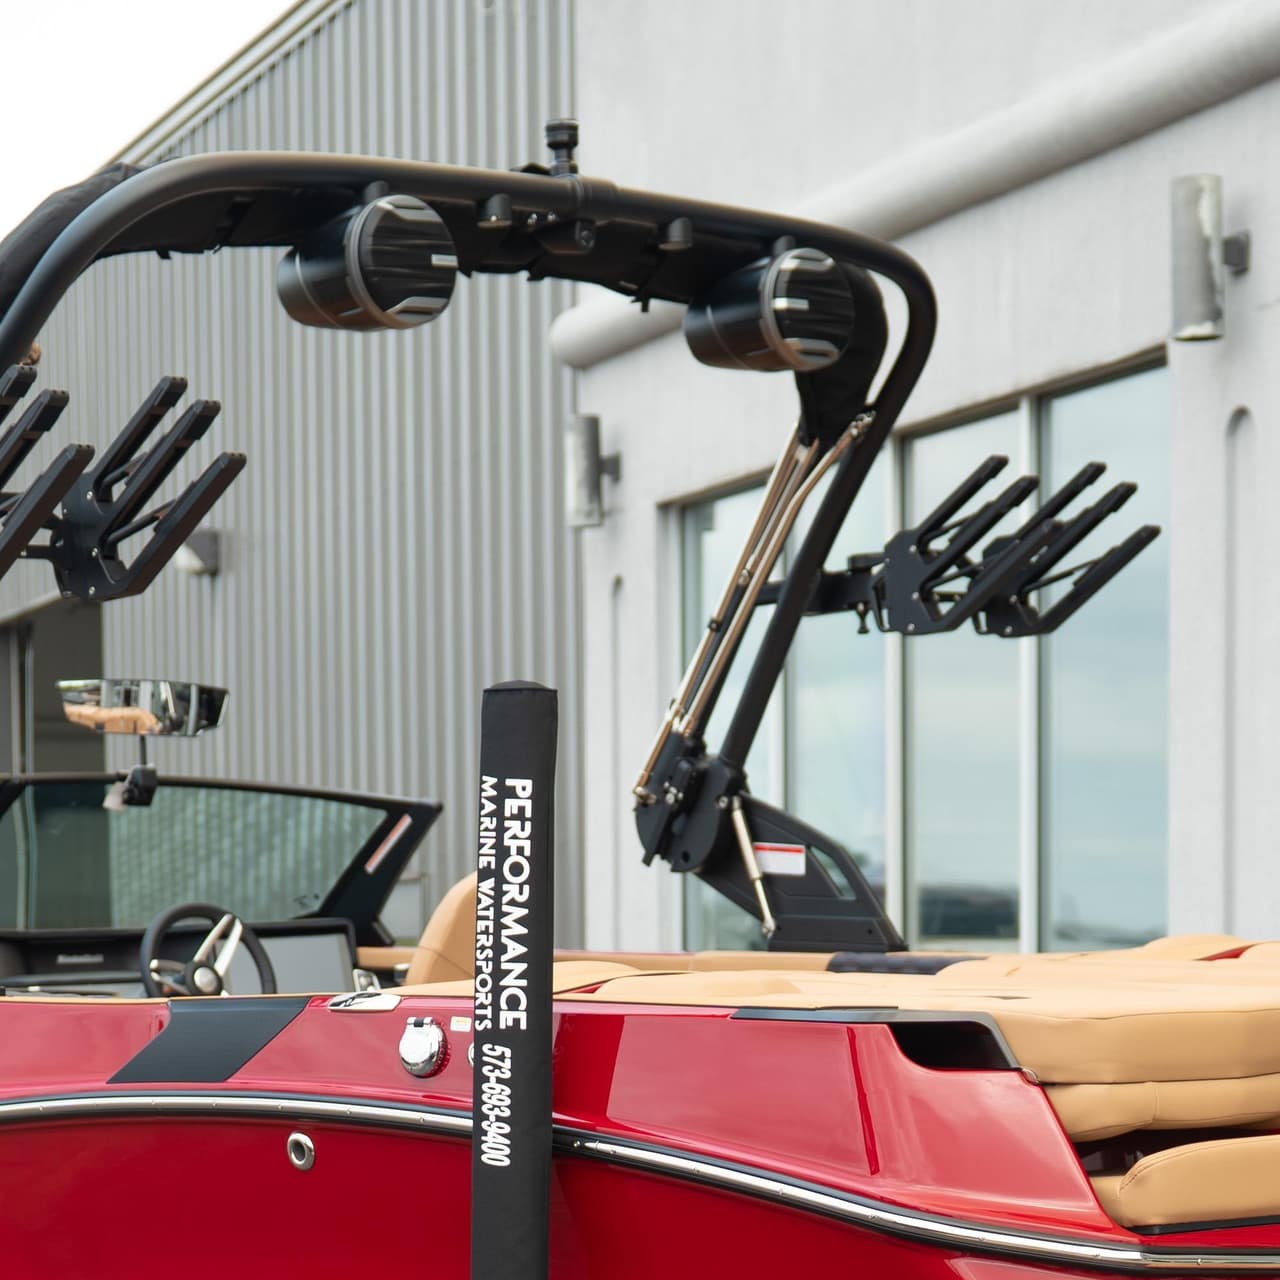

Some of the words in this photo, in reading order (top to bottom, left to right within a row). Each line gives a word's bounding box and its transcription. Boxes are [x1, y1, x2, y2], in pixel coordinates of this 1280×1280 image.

[478, 775, 498, 869] MARINE
[475, 877, 495, 1031] WATERSPORTS
[498, 778, 533, 1030] PERFORMANCE
[481, 1043, 511, 1167] 573-693-9400
